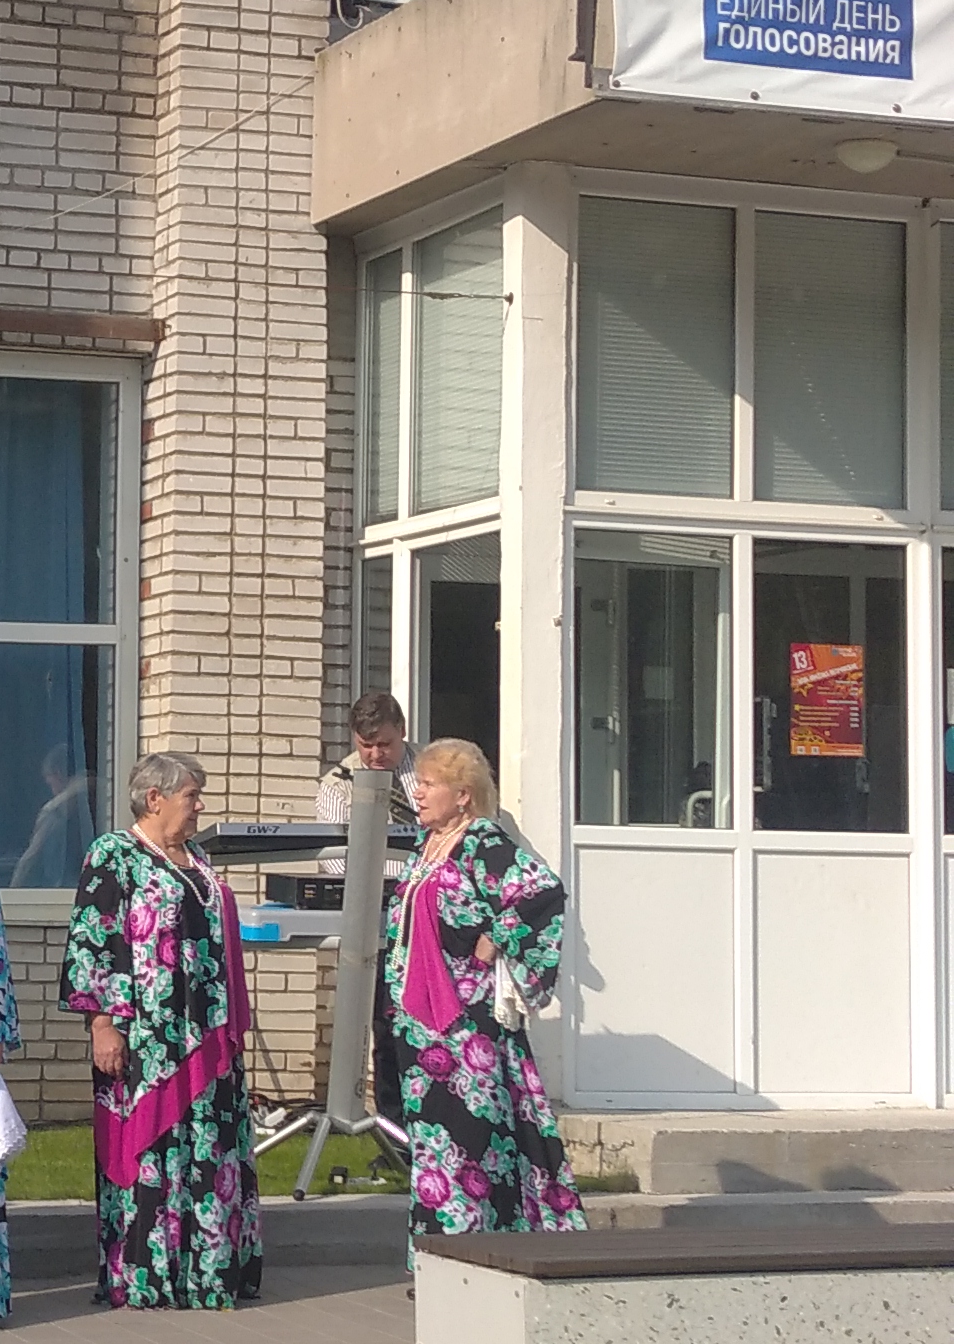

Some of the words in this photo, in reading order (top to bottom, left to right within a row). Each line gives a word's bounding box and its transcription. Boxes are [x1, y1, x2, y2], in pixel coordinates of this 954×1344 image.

[717, 22, 901, 65] голосования
[792, 650, 808, 670] 13
[246, 825, 281, 834] GW-7
